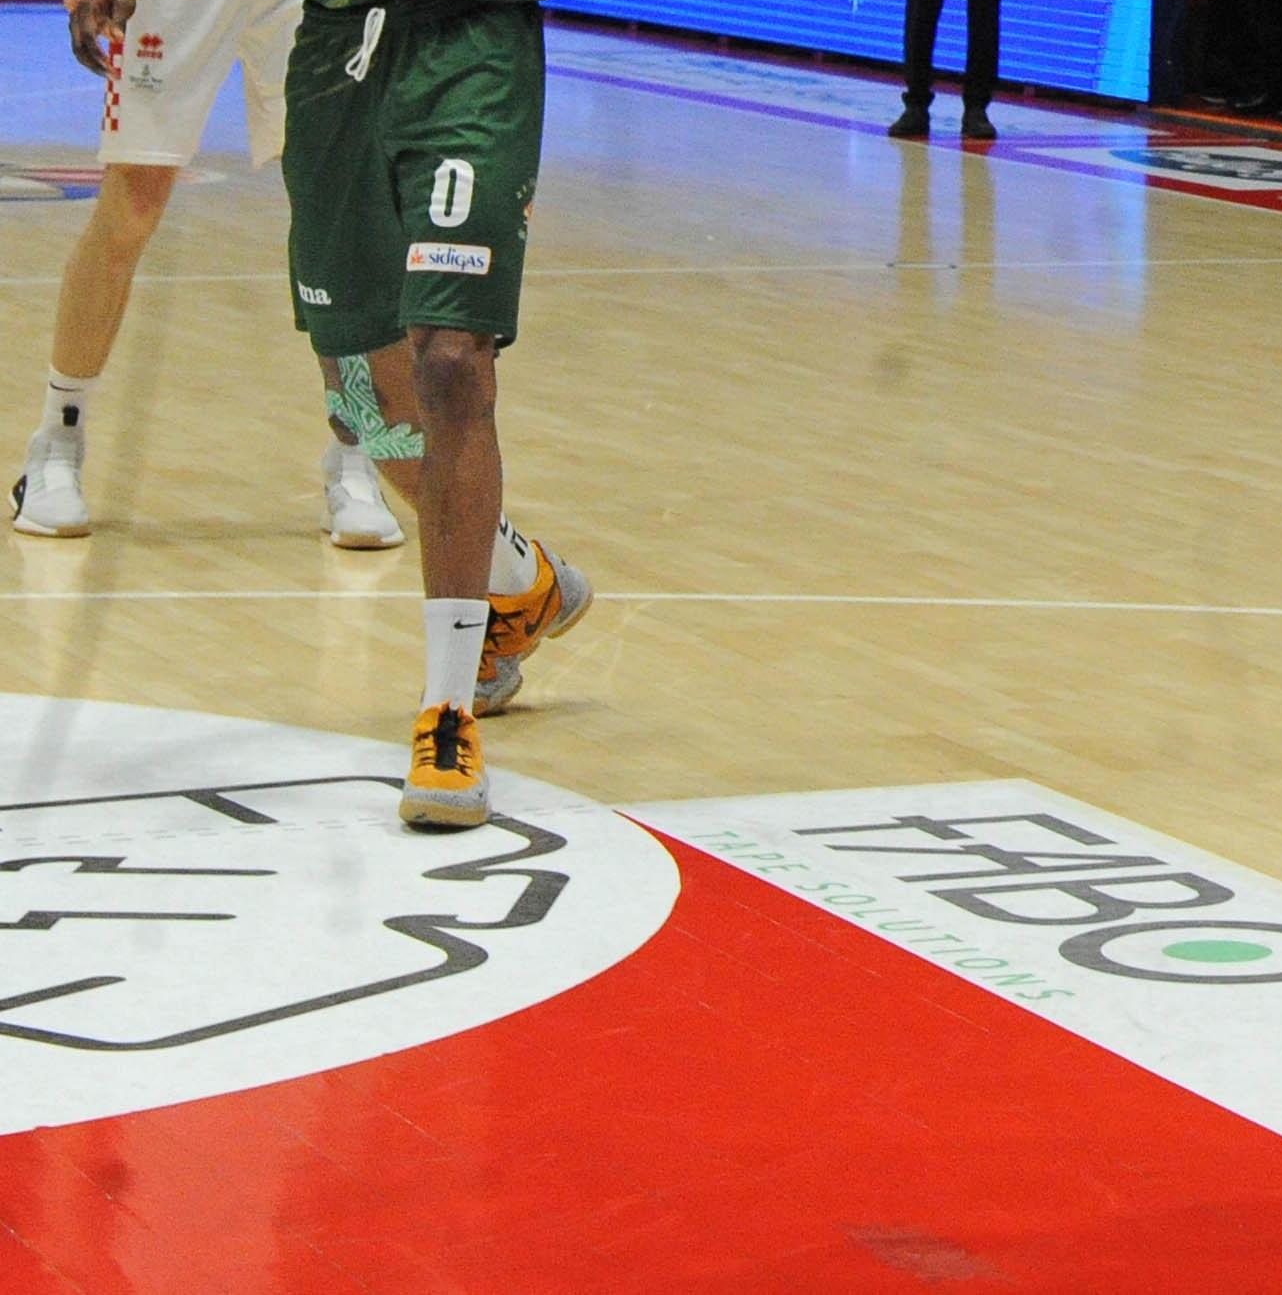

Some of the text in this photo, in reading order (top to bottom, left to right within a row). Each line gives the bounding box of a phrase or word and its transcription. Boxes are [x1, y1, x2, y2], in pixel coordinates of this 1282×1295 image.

[430, 158, 475, 228] 0
[688, 829, 1077, 1003] TAPE SOLUTIONS
